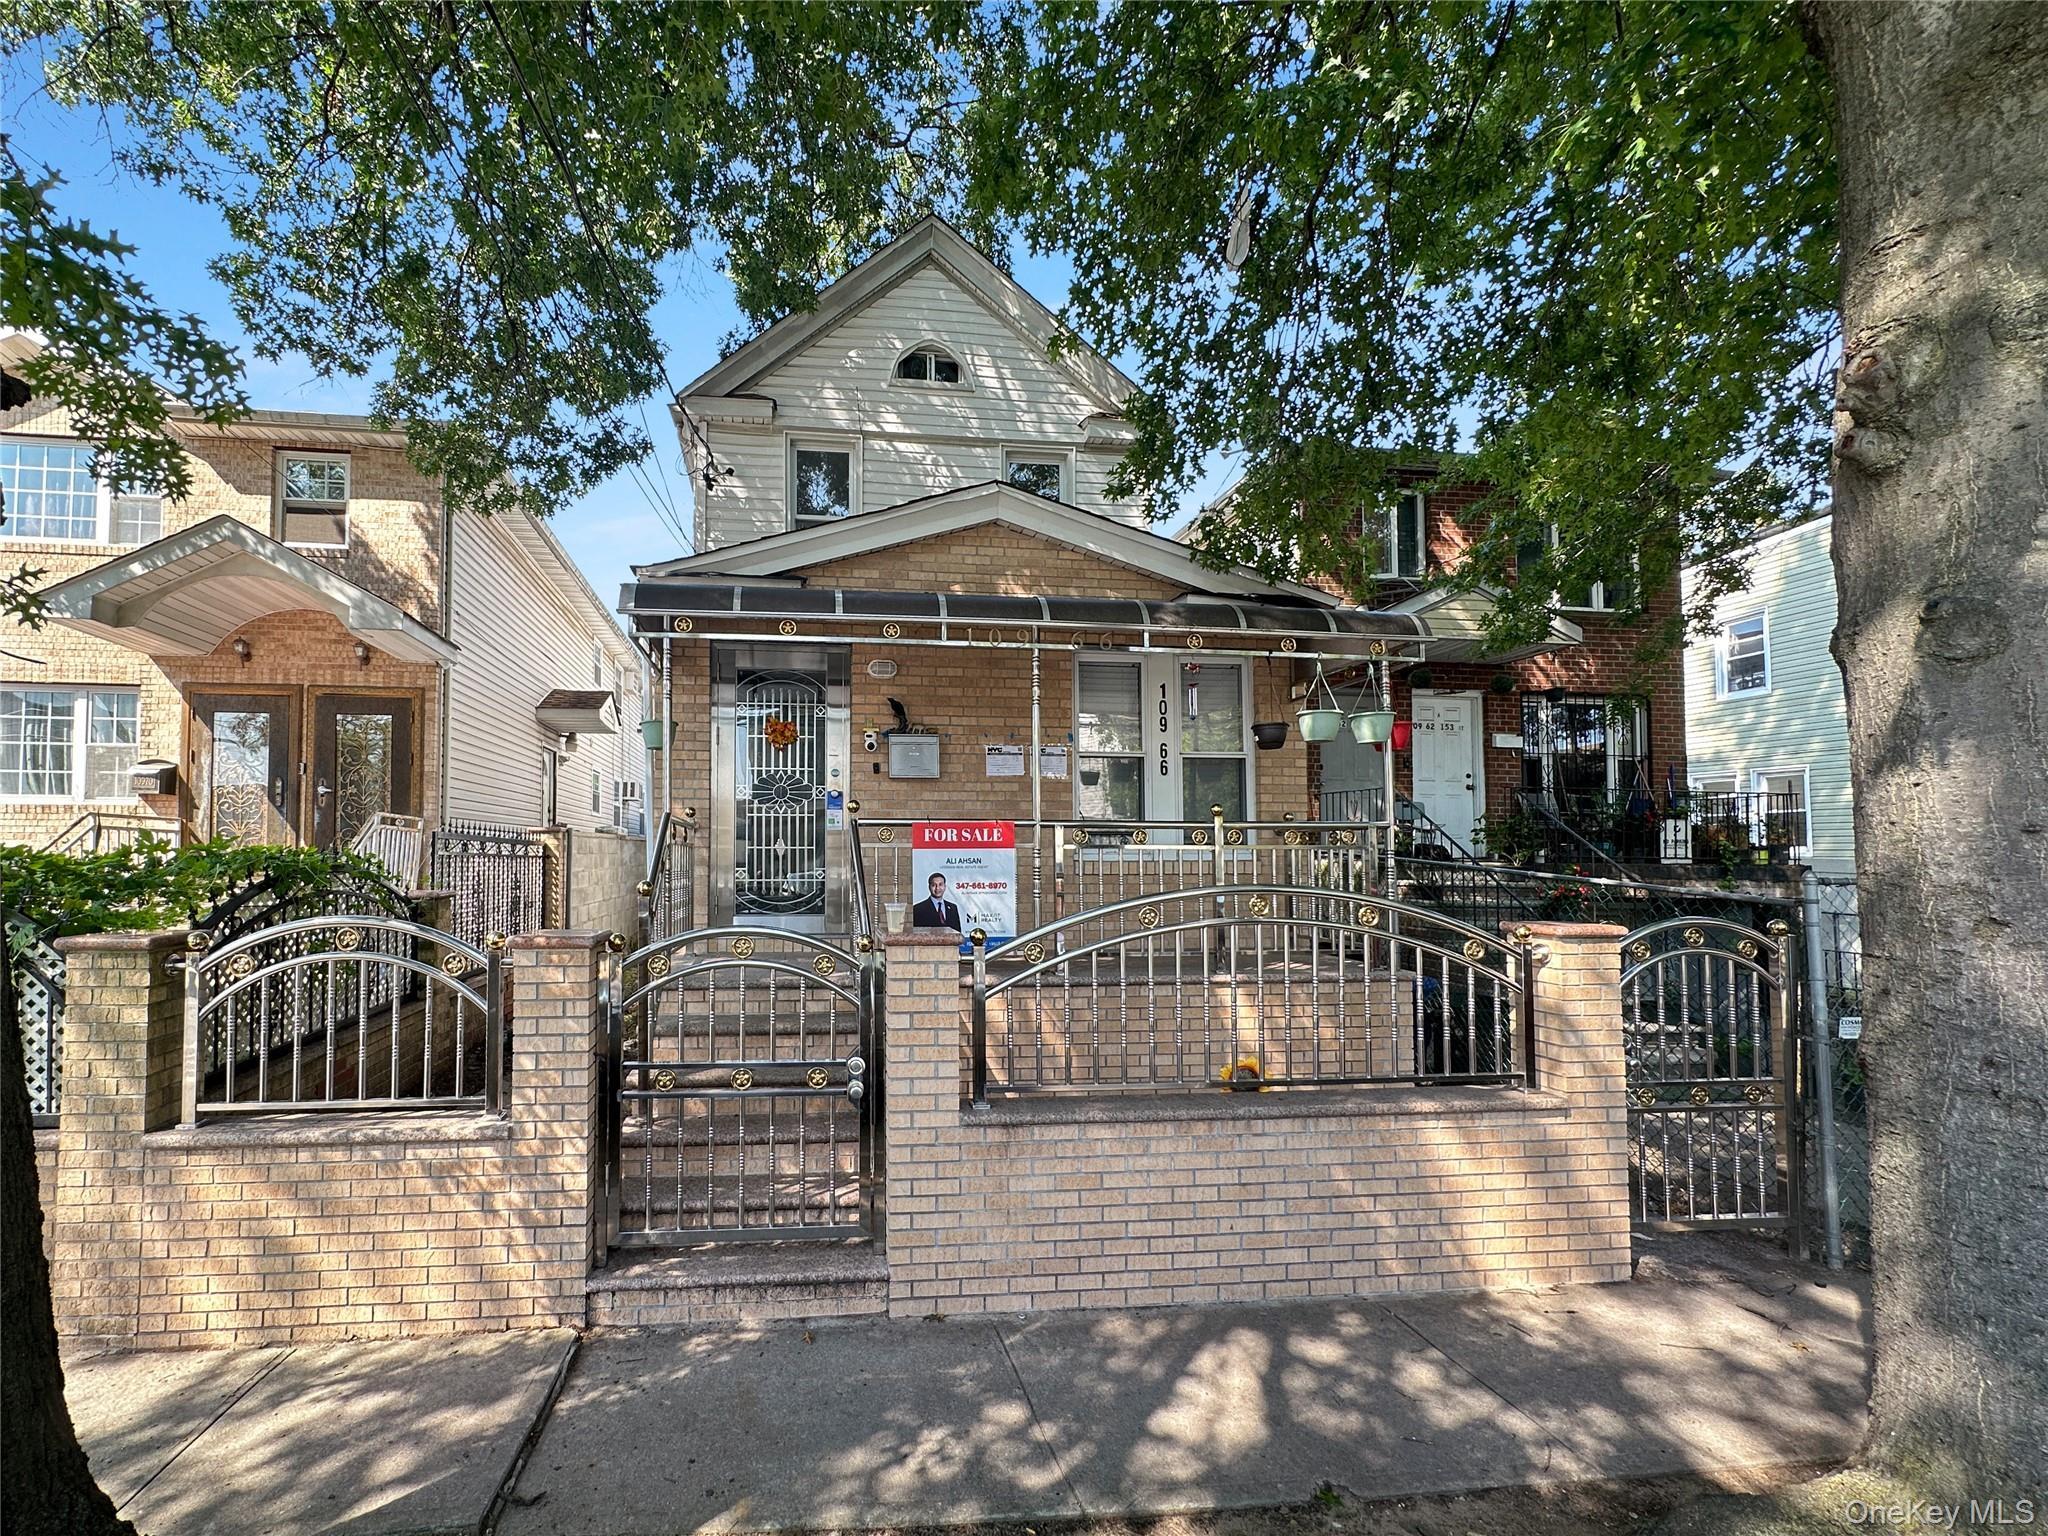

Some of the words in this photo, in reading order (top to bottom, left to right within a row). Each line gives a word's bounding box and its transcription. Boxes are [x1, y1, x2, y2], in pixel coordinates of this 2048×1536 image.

[965, 627, 1030, 649] 109
[1071, 631, 1112, 650] 66
[1158, 683, 1168, 733] 109
[1425, 722, 1435, 730] 62
[1440, 723, 1454, 731] 153
[1159, 743, 1169, 776] 66
[924, 828, 959, 842] FOR
[961, 827, 1003, 842] SALE
[945, 857, 957, 865] ALI
[957, 857, 982, 865] AHSAN
